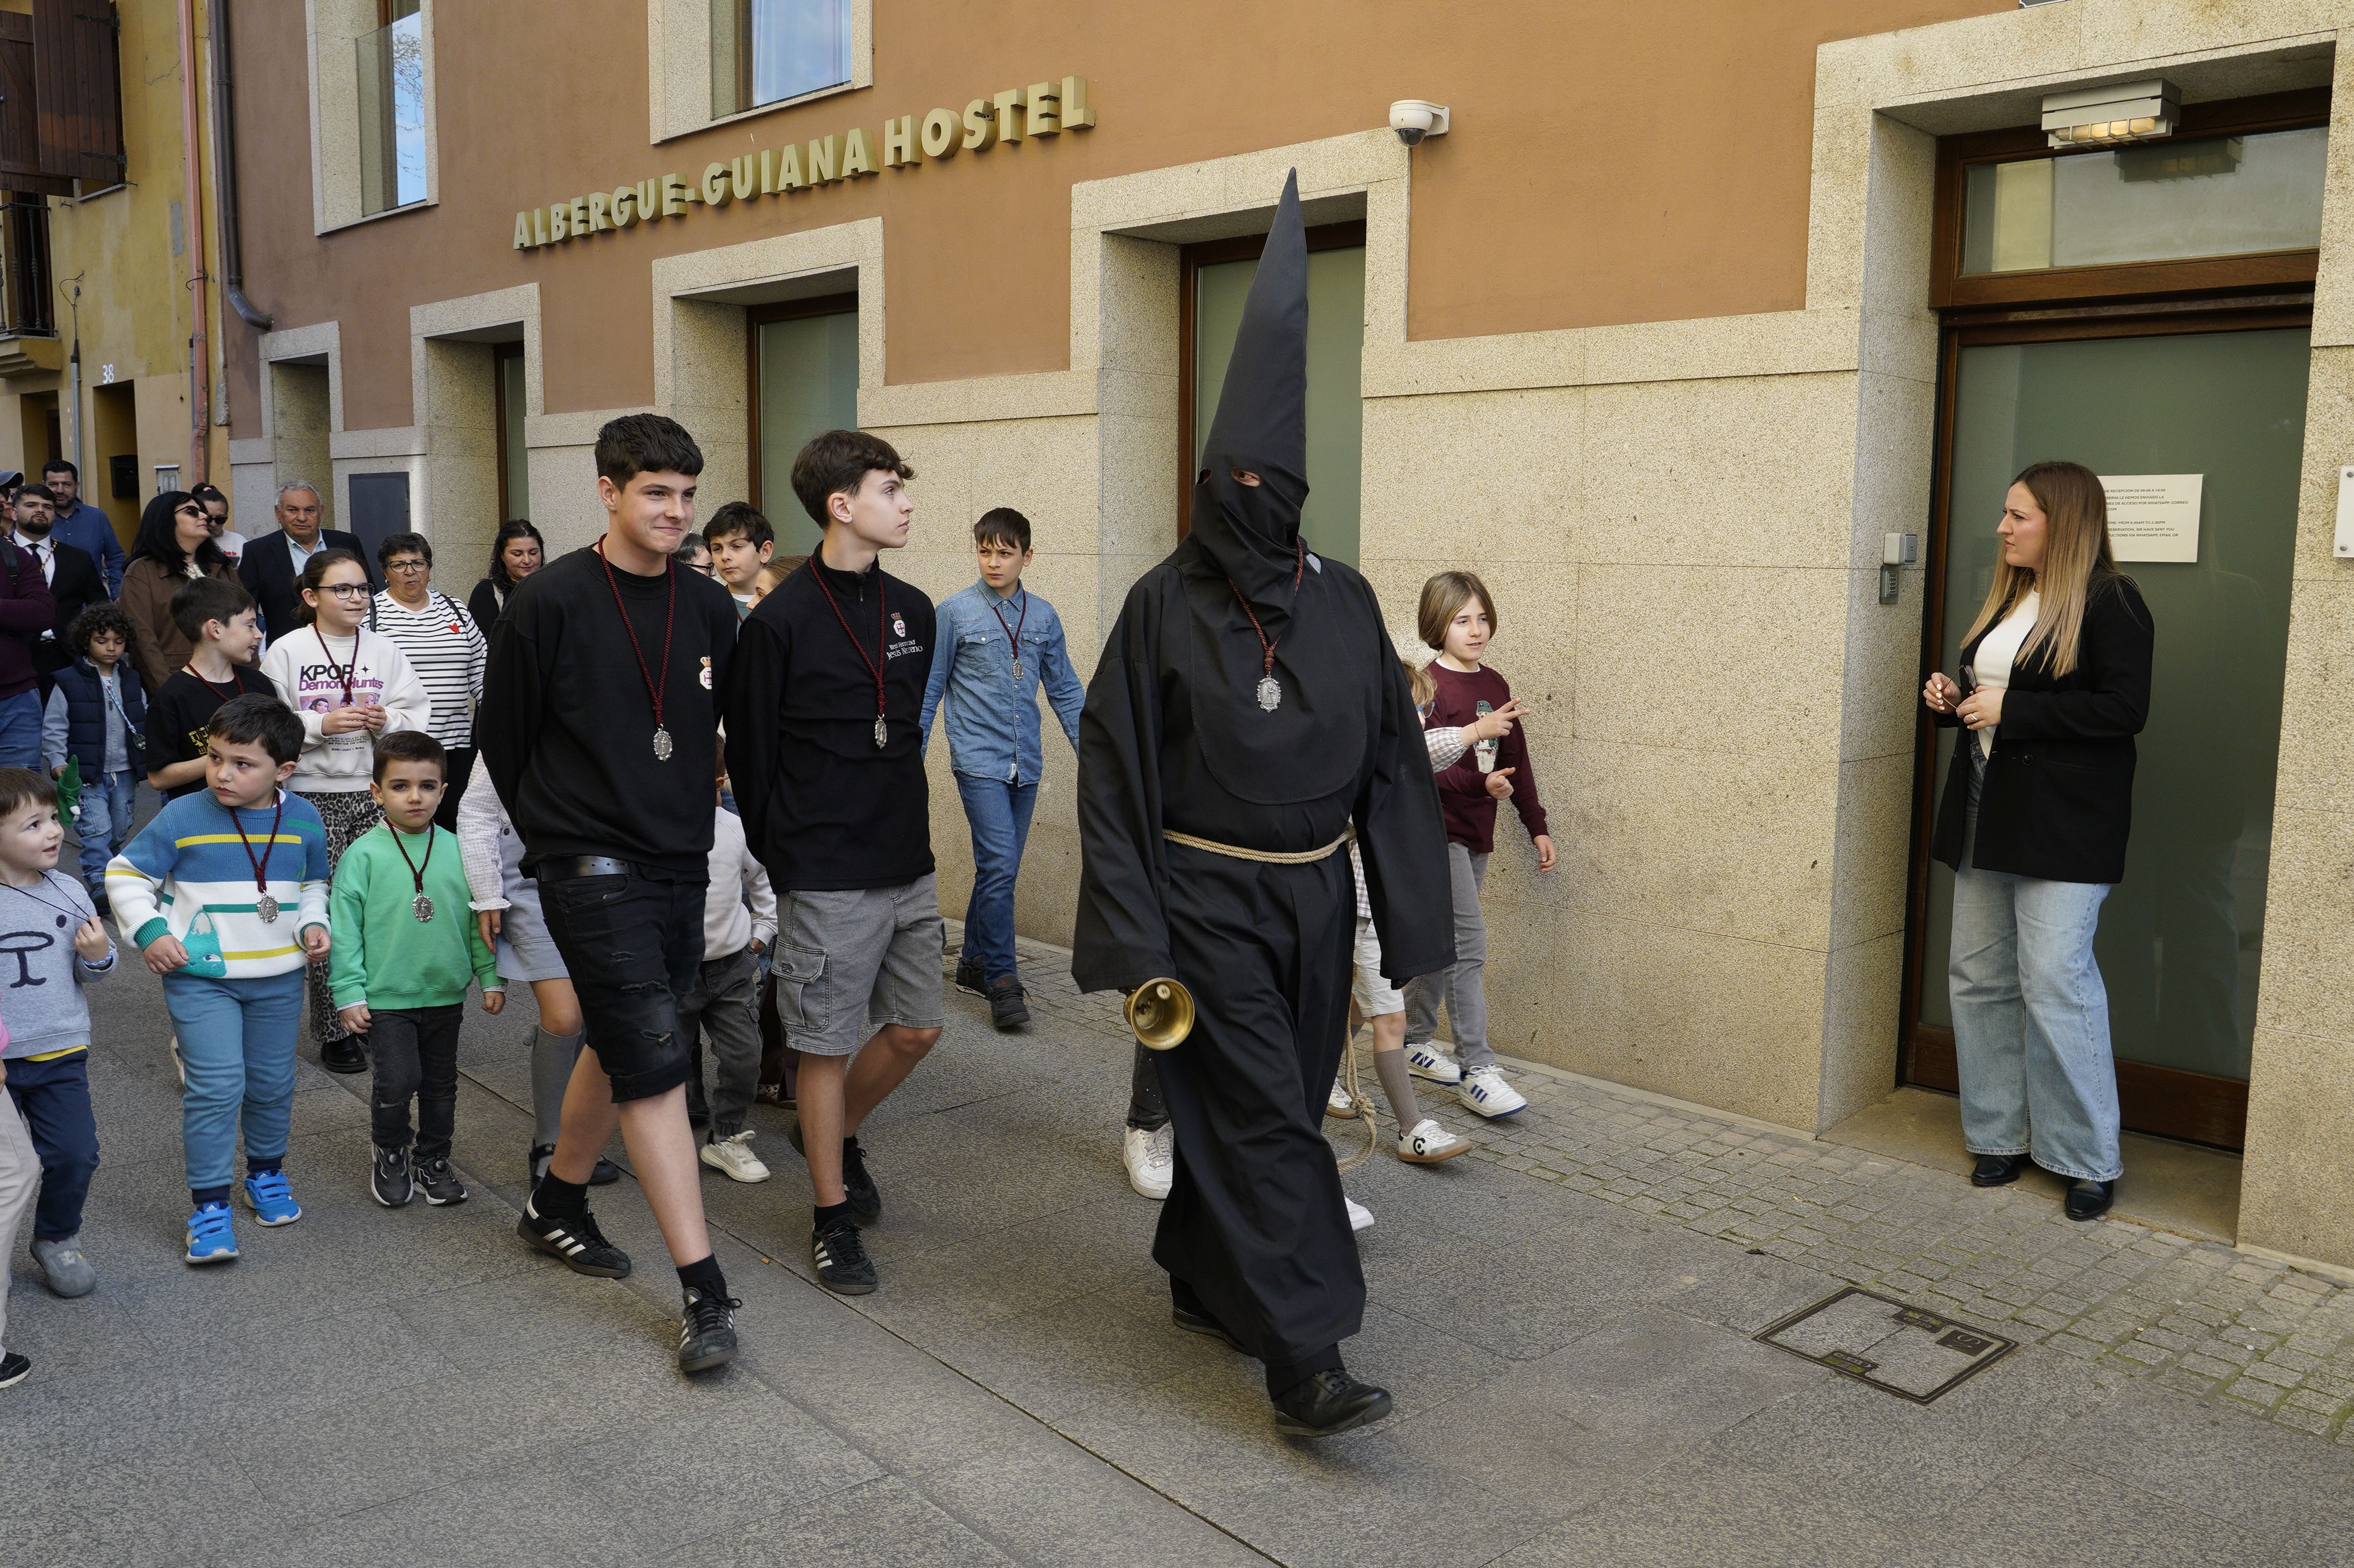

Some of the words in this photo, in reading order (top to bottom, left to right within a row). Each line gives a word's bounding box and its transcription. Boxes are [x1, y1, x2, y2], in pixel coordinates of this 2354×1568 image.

[884, 75, 1096, 169] HOSTEL
[102, 364, 114, 384] 38
[300, 664, 352, 681] KPOP
[298, 679, 343, 691] Demon
